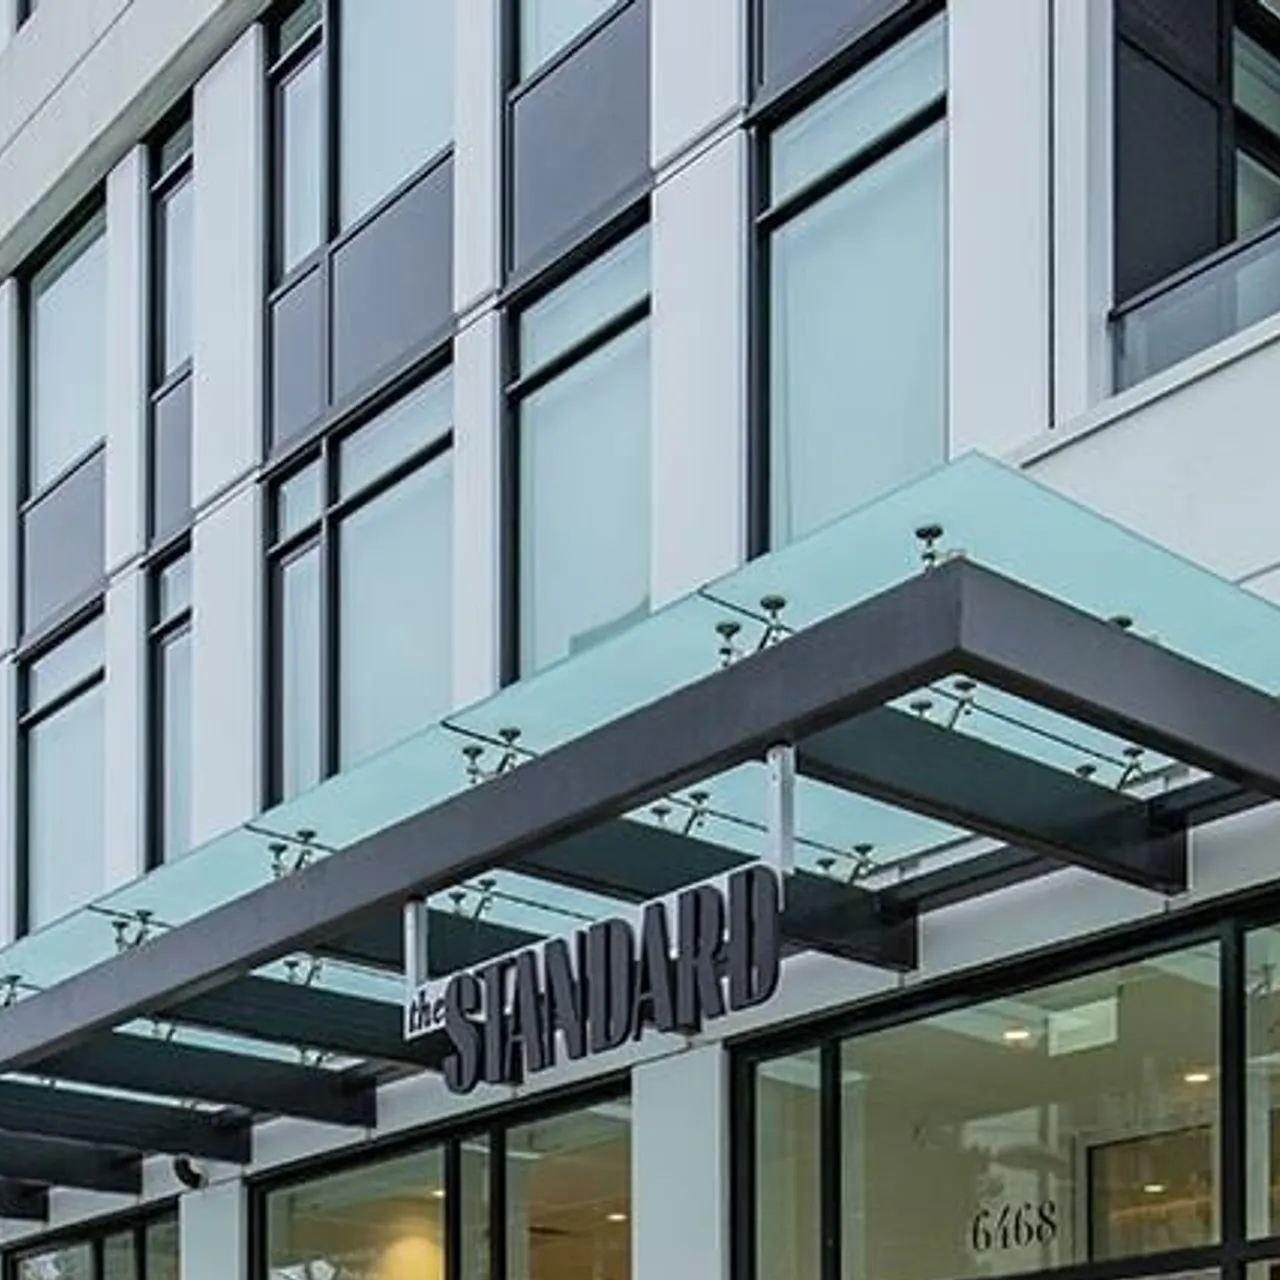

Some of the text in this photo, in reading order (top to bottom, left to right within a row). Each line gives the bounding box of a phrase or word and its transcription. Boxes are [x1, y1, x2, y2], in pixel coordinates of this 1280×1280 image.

[409, 865, 783, 1095] the STANDARD
[972, 1200, 1057, 1251] 6468
